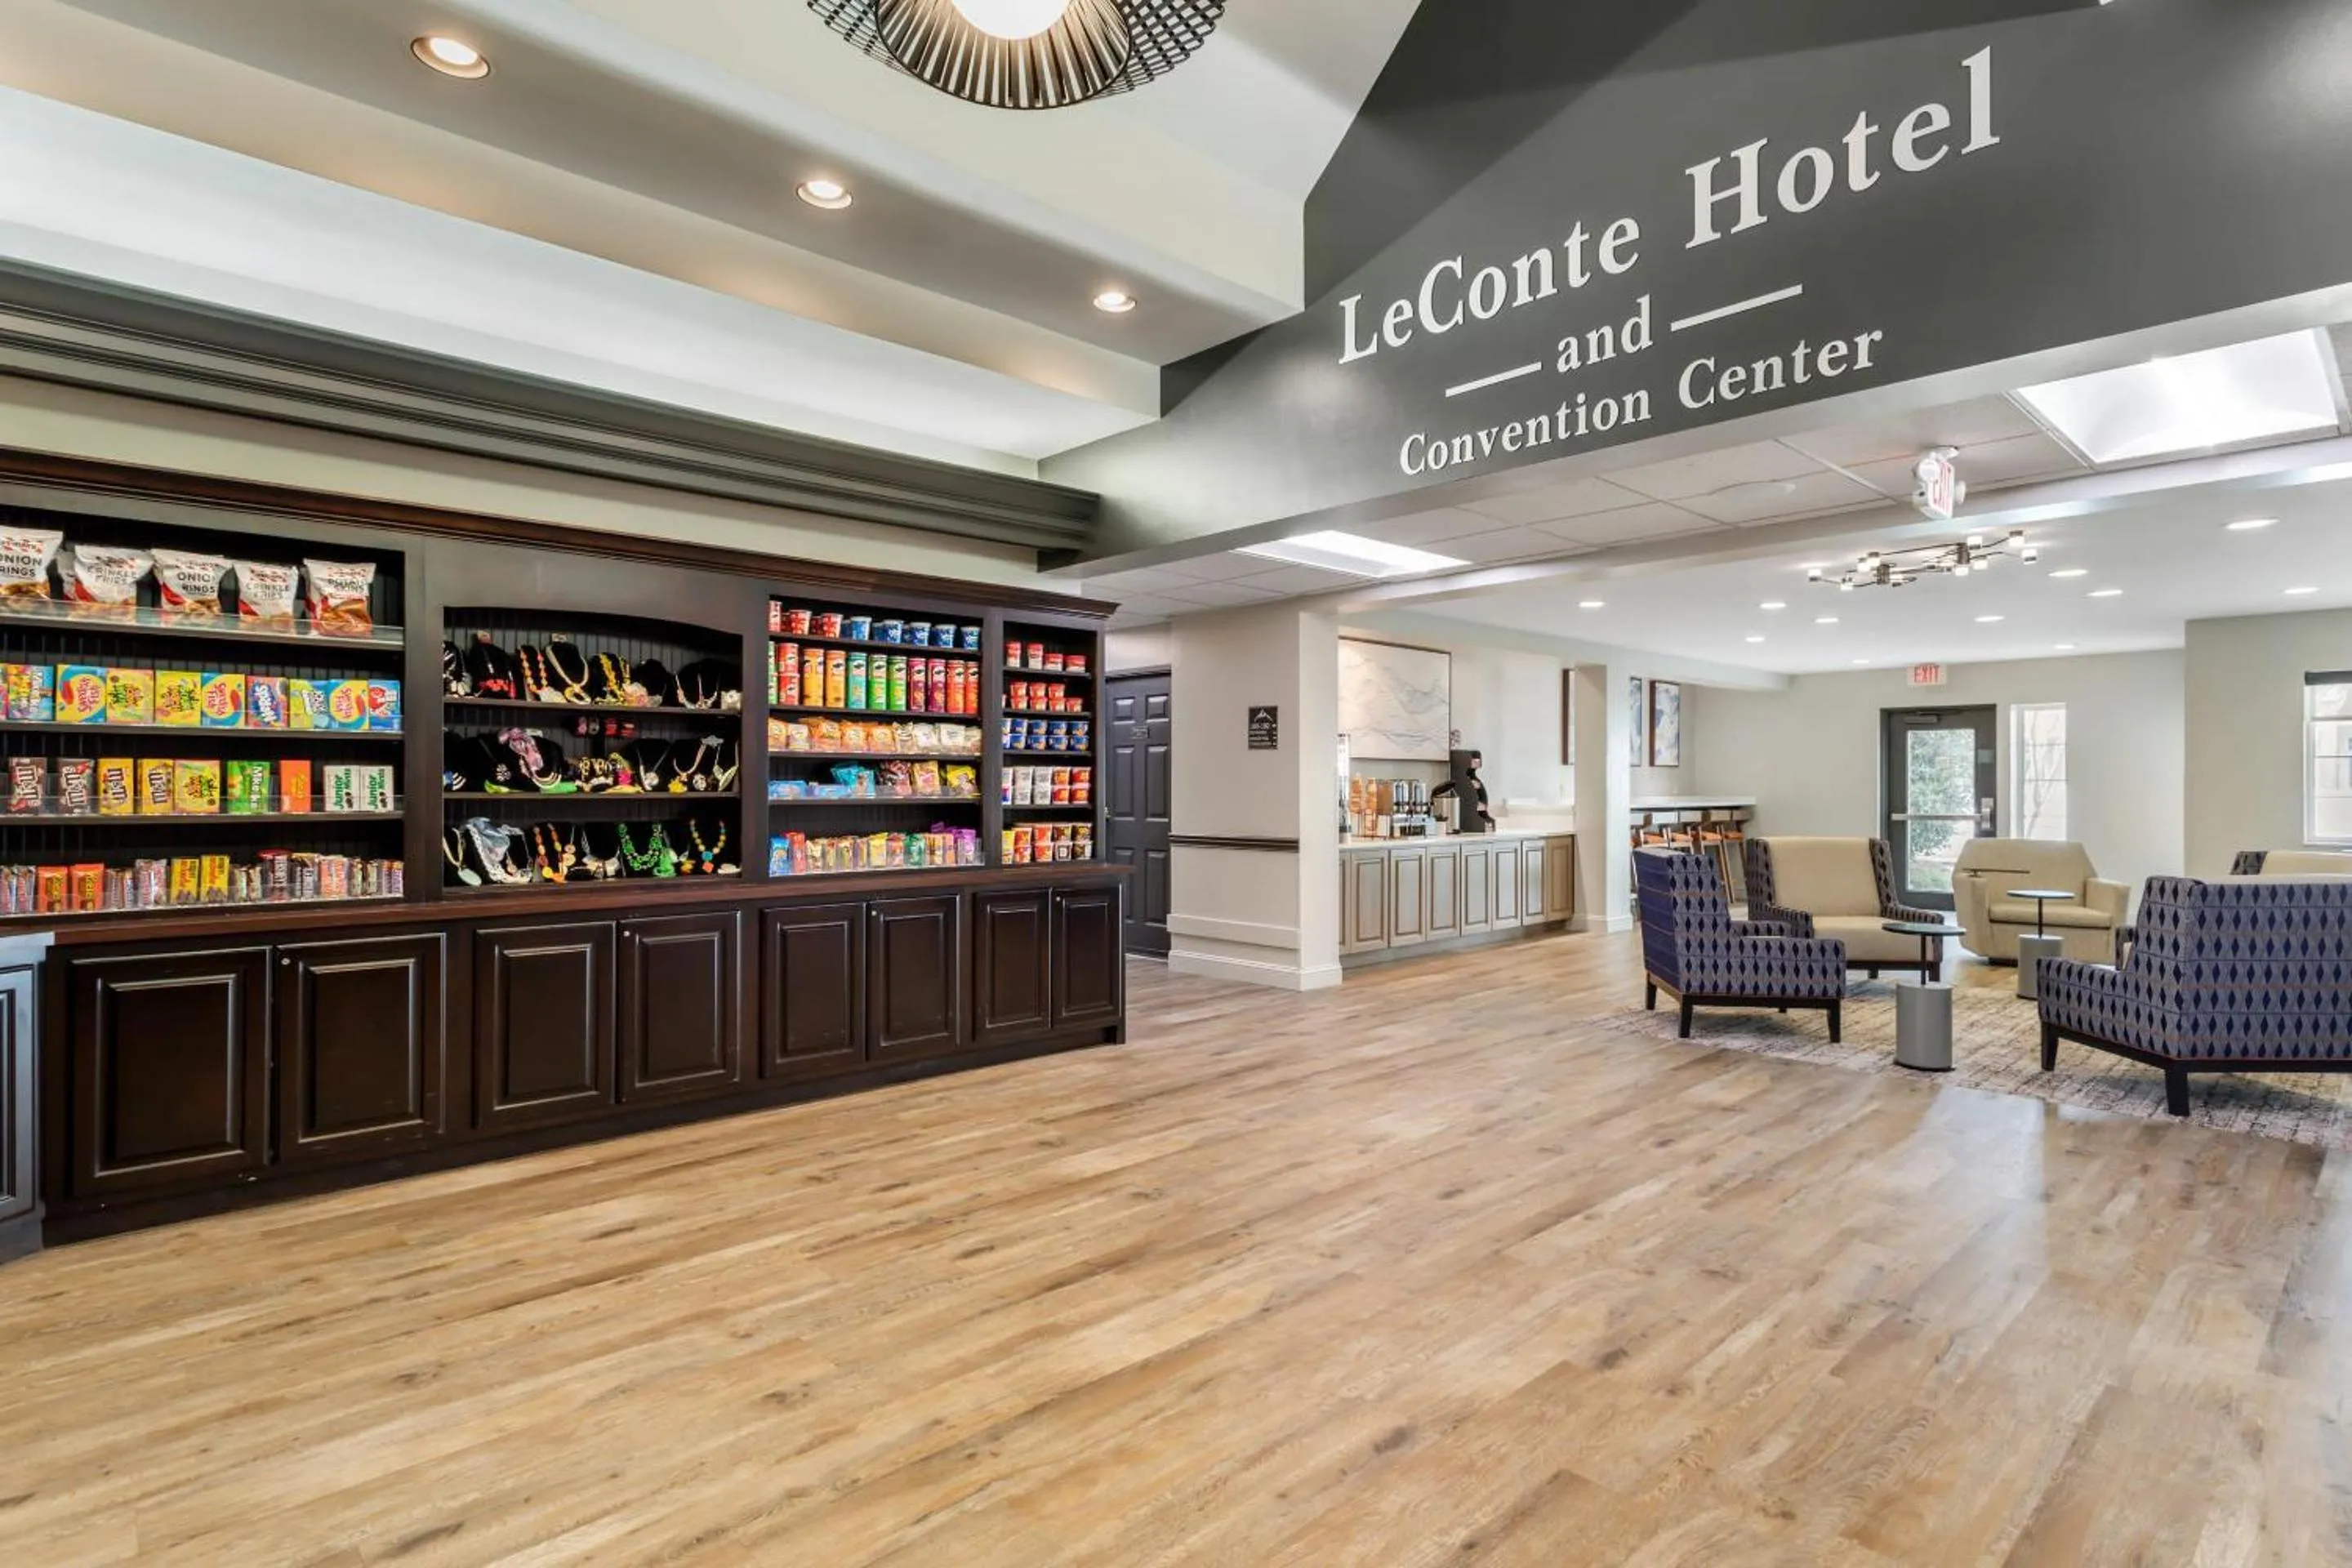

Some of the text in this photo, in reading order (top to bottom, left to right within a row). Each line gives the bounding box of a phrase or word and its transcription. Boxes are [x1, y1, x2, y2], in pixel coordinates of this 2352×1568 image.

[1338, 45, 2001, 366] LeConte Hotel
[1556, 293, 1654, 373] and
[1399, 330, 1883, 477] Convention Center
[1913, 665, 1940, 683] EXIT
[333, 774, 345, 809] Junior
[368, 774, 379, 809] Junior
